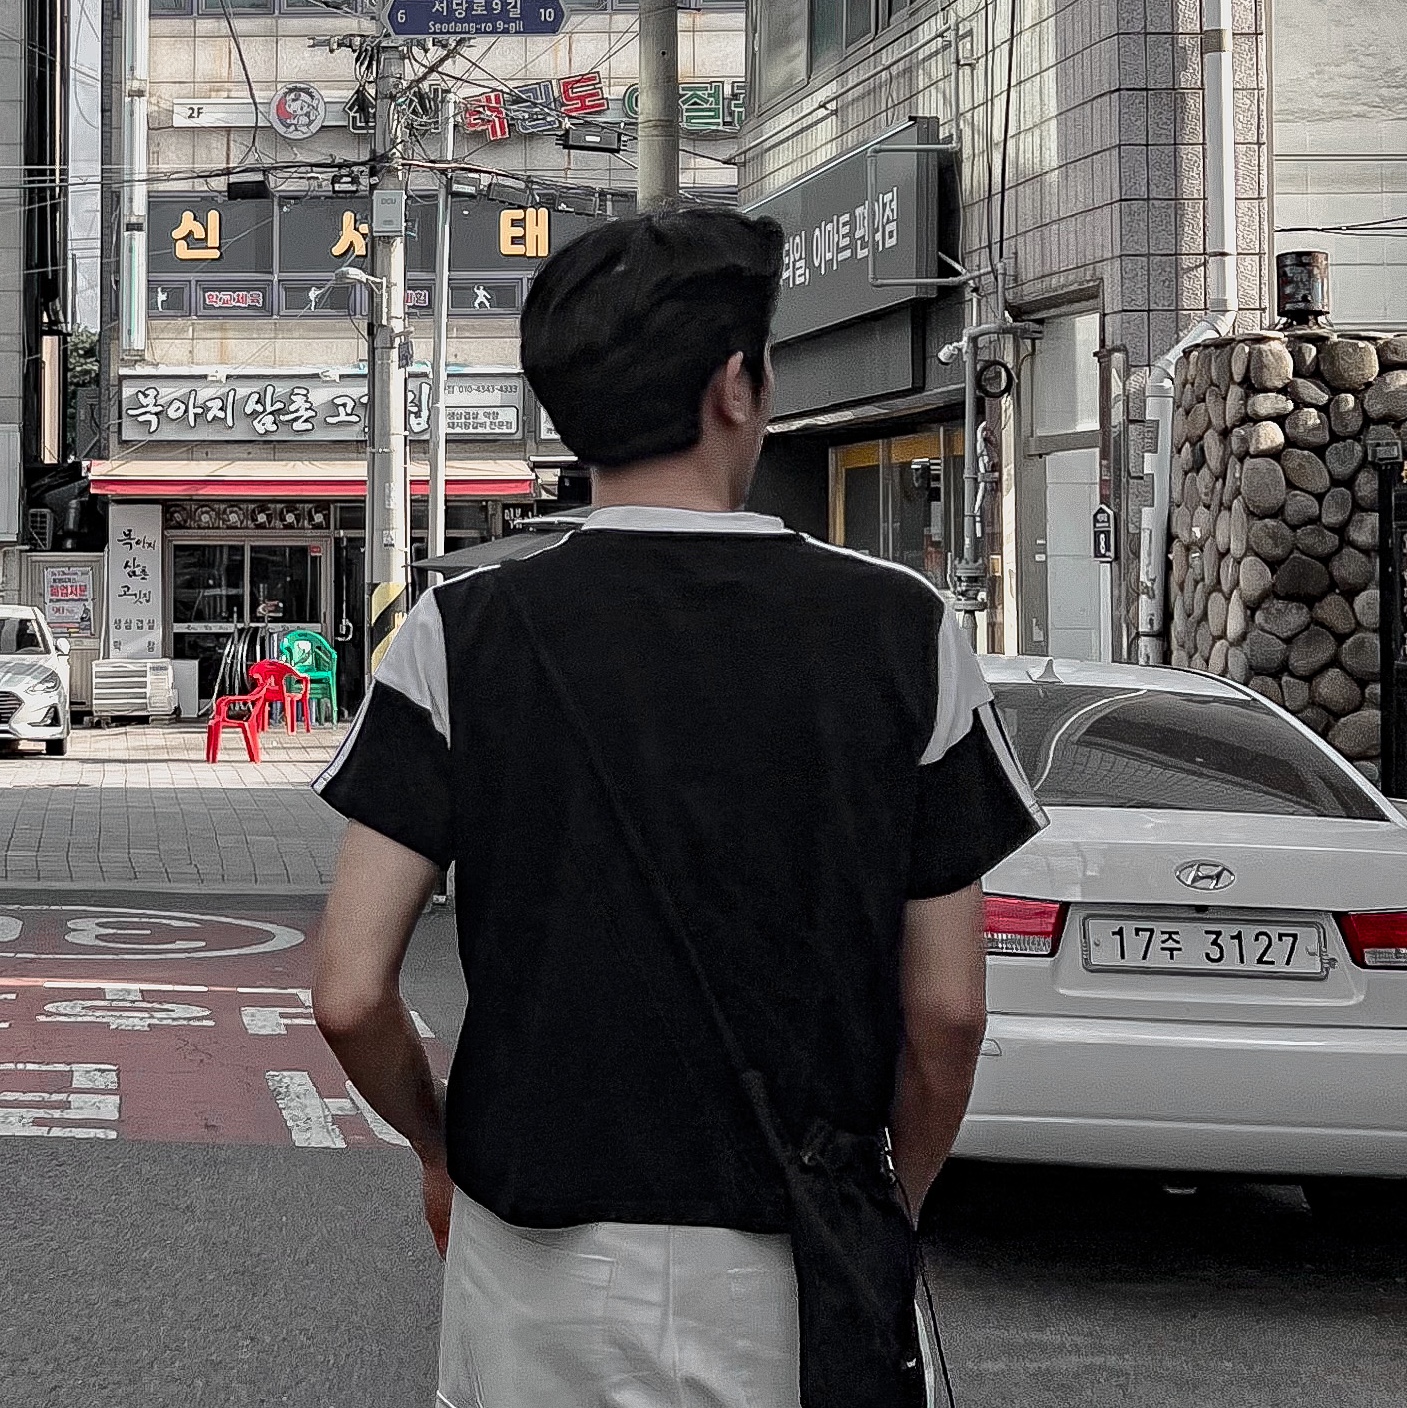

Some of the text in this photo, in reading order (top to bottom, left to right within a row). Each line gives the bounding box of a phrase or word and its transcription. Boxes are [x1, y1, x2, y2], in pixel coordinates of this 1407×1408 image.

[397, 9, 406, 23] 6
[539, 9, 555, 22] 10
[428, 21, 524, 34] Seodang-ro 9-gil
[187, 106, 204, 118] 2F
[813, 213, 852, 276] 이마트
[854, 186, 898, 260] 편의점
[324, 381, 432, 434] 고집
[1111, 925, 1300, 967] 17주 3127
